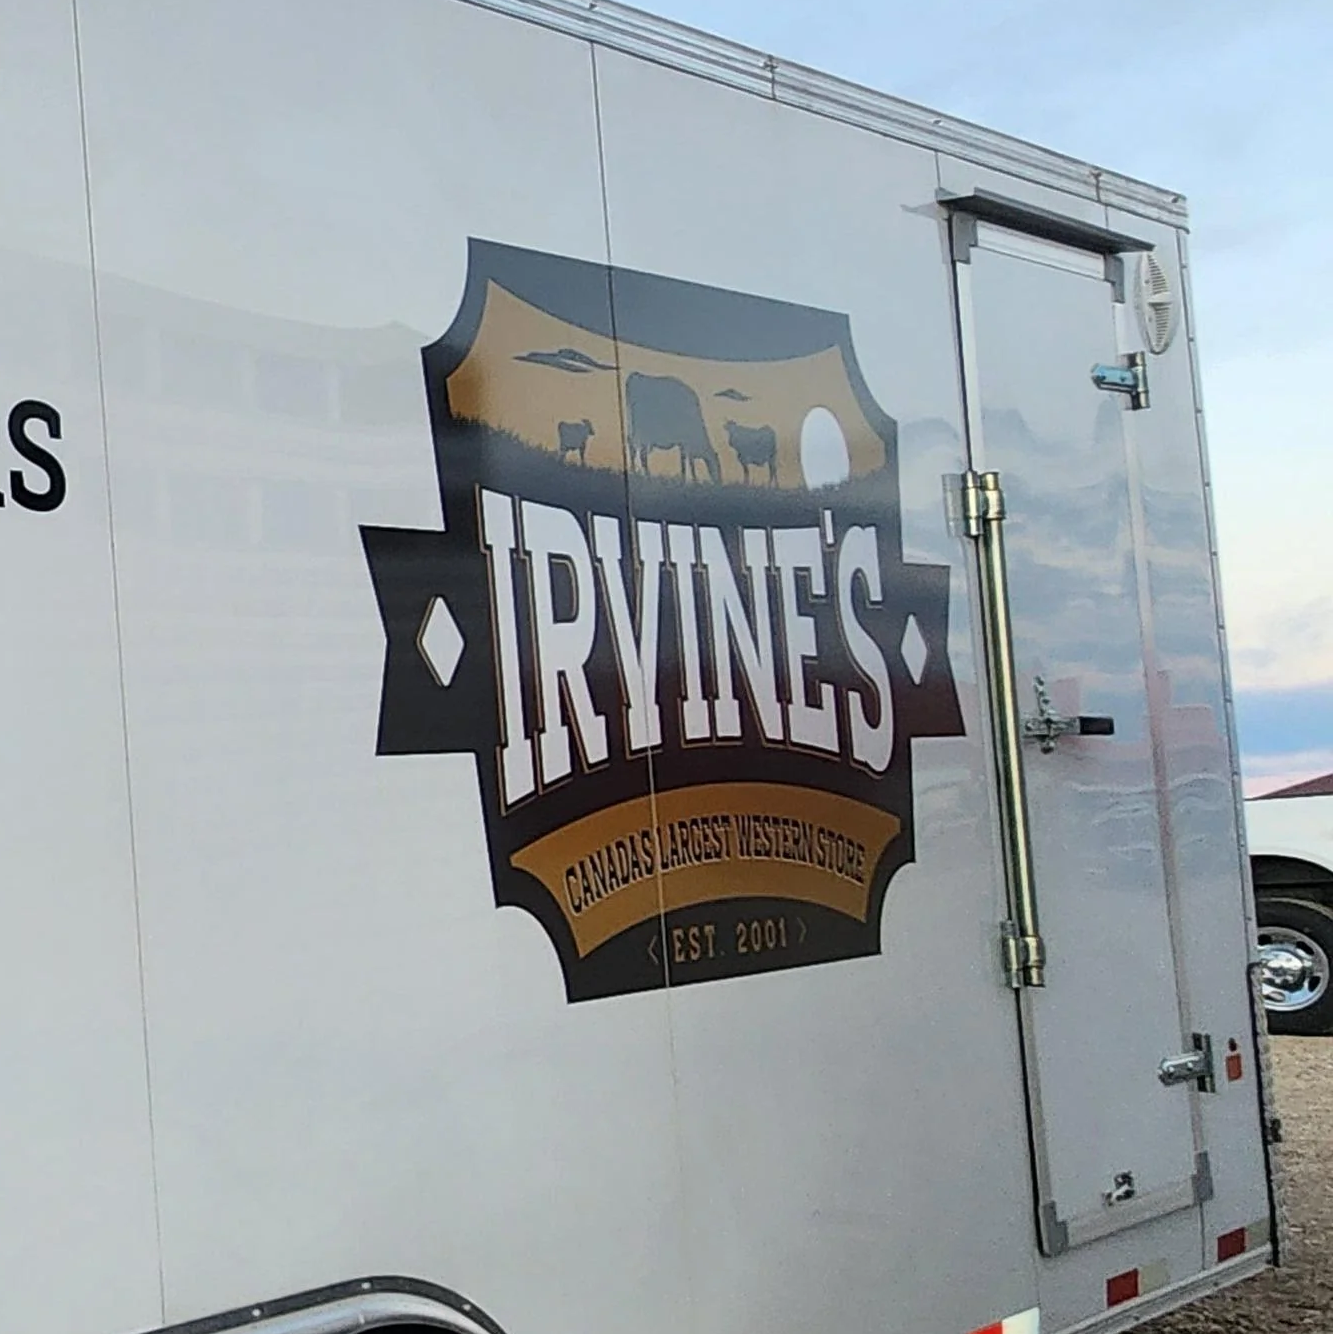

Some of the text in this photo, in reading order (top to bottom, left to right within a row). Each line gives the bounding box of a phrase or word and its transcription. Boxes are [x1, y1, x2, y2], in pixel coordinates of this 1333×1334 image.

[477, 487, 895, 814] IRVINE'S
[656, 816, 732, 873] LARGEST
[733, 816, 813, 866] WESTERN
[815, 827, 867, 886] STORE
[736, 919, 789, 954] 2001
